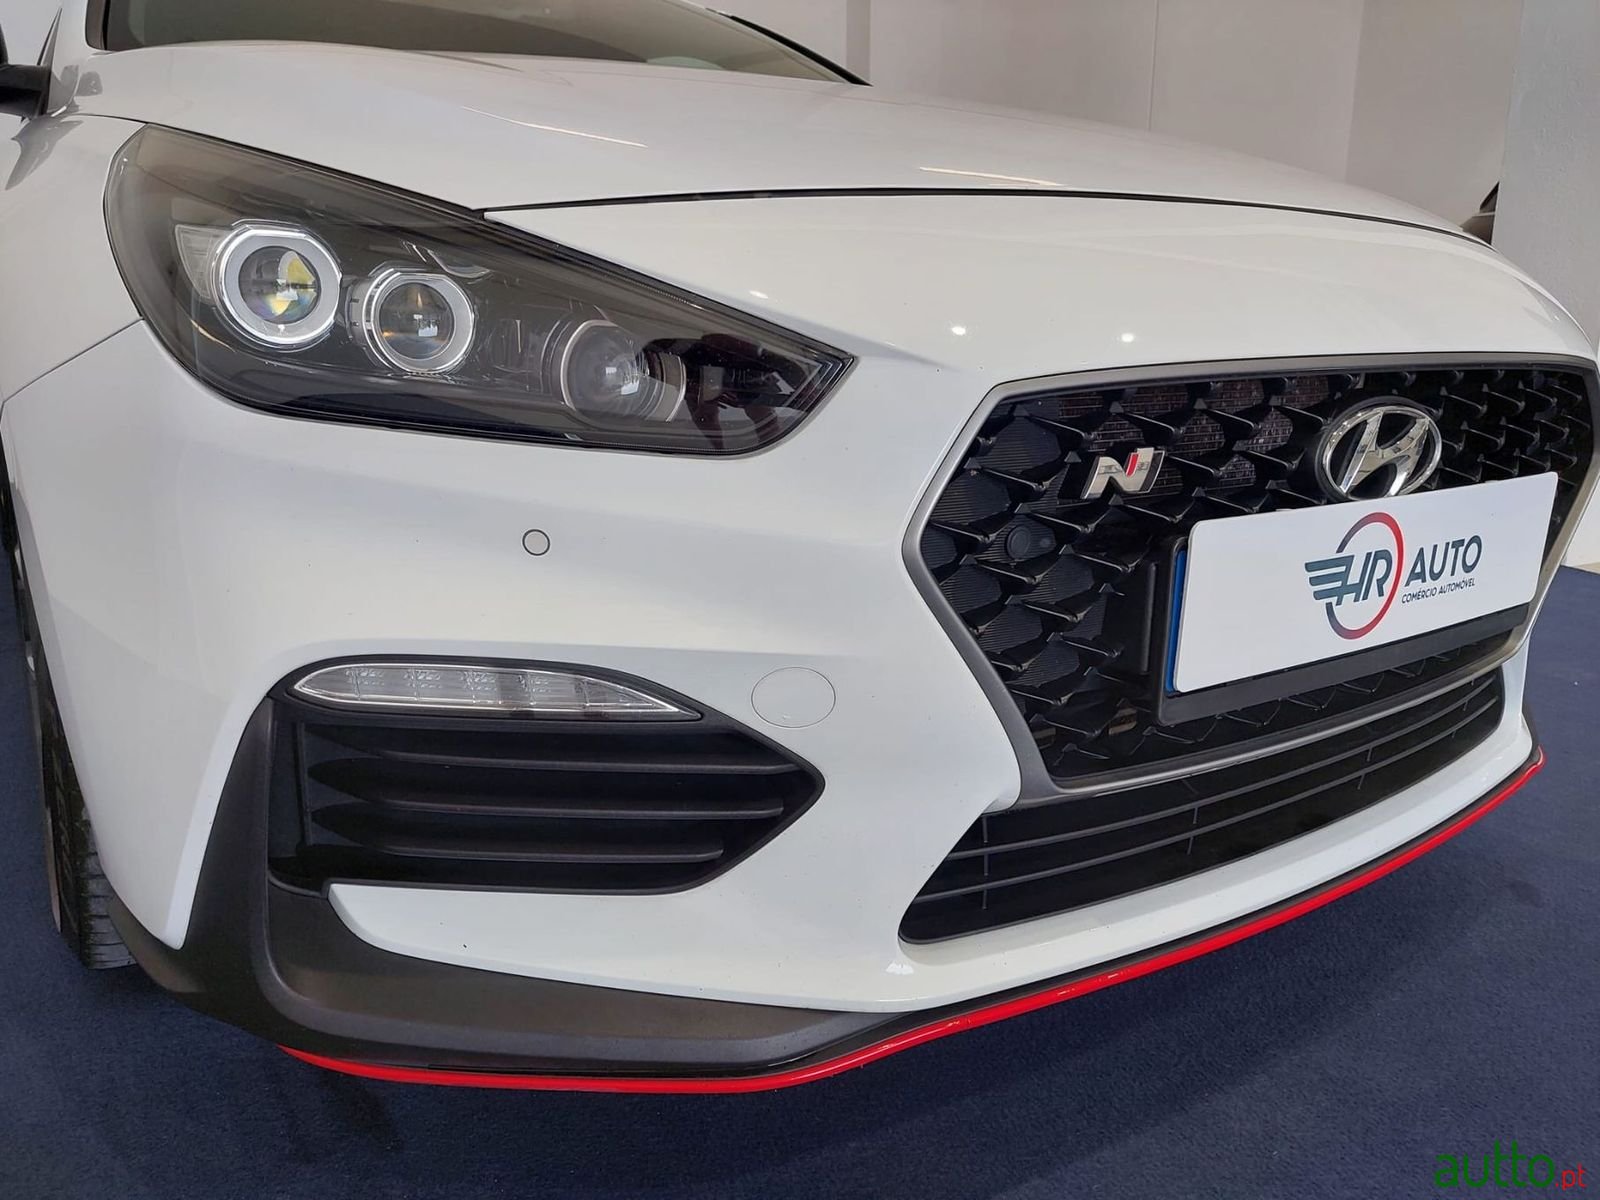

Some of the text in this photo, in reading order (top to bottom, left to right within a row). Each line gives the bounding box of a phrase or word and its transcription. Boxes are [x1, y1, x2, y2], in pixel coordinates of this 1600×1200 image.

[1080, 447, 1165, 499] N
[1320, 535, 1482, 606] HR AUTO
[1401, 578, 1475, 604] COMÉRCIO AUTOMÓVEL
